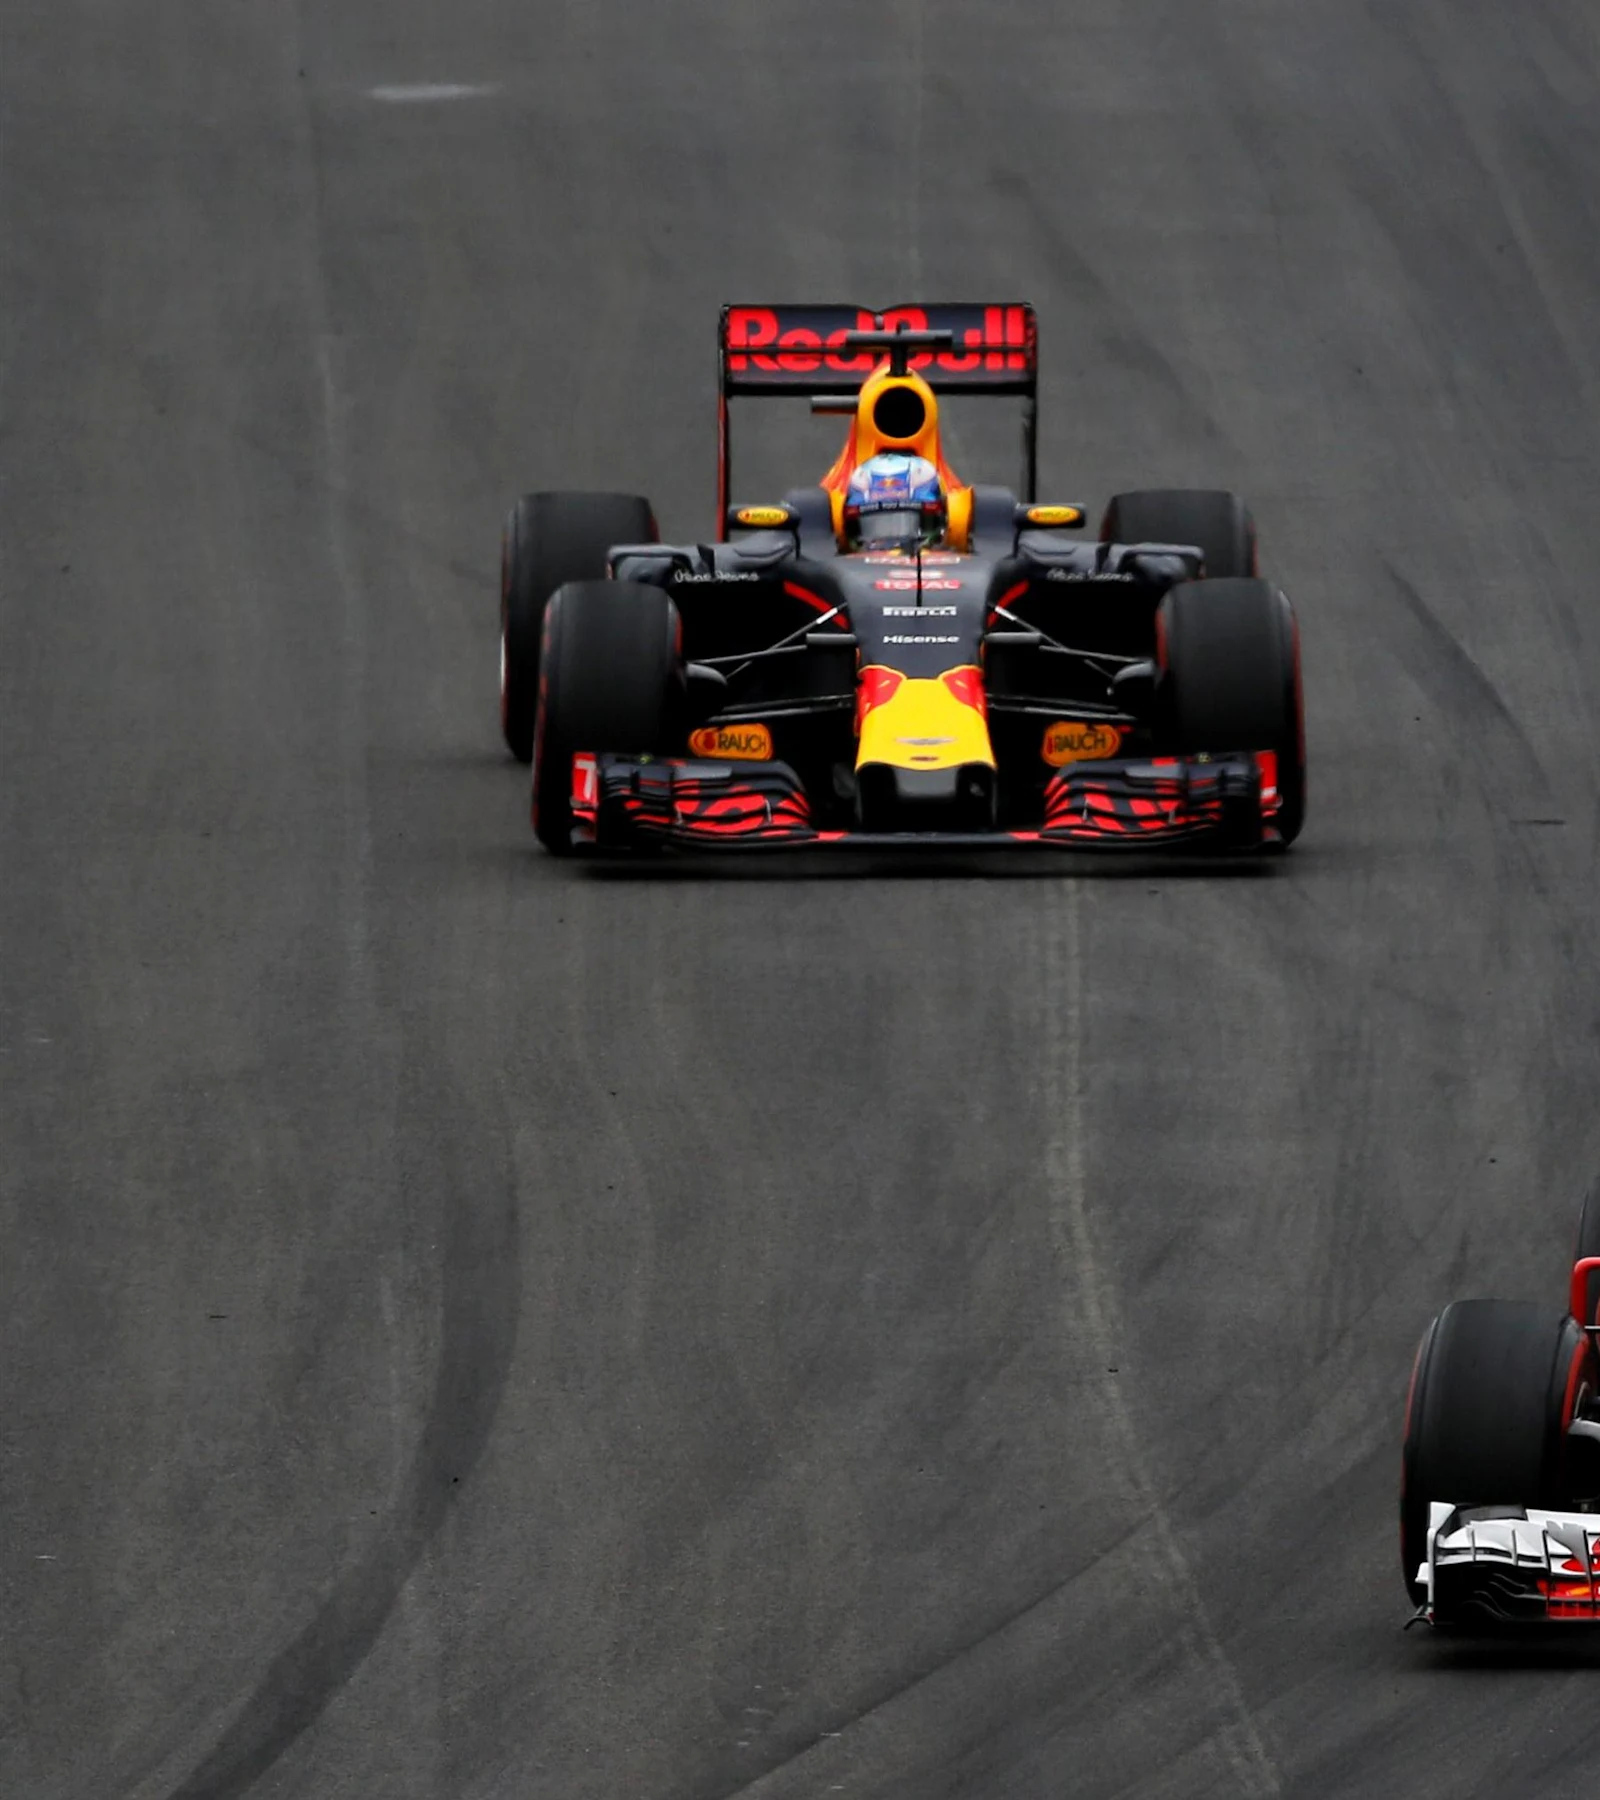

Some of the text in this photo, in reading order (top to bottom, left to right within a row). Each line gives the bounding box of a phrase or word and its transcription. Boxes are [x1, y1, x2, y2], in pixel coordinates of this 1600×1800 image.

[729, 307, 1026, 371] Red Bull
[882, 635, 960, 644] Hisense
[718, 731, 767, 753] RAUCH
